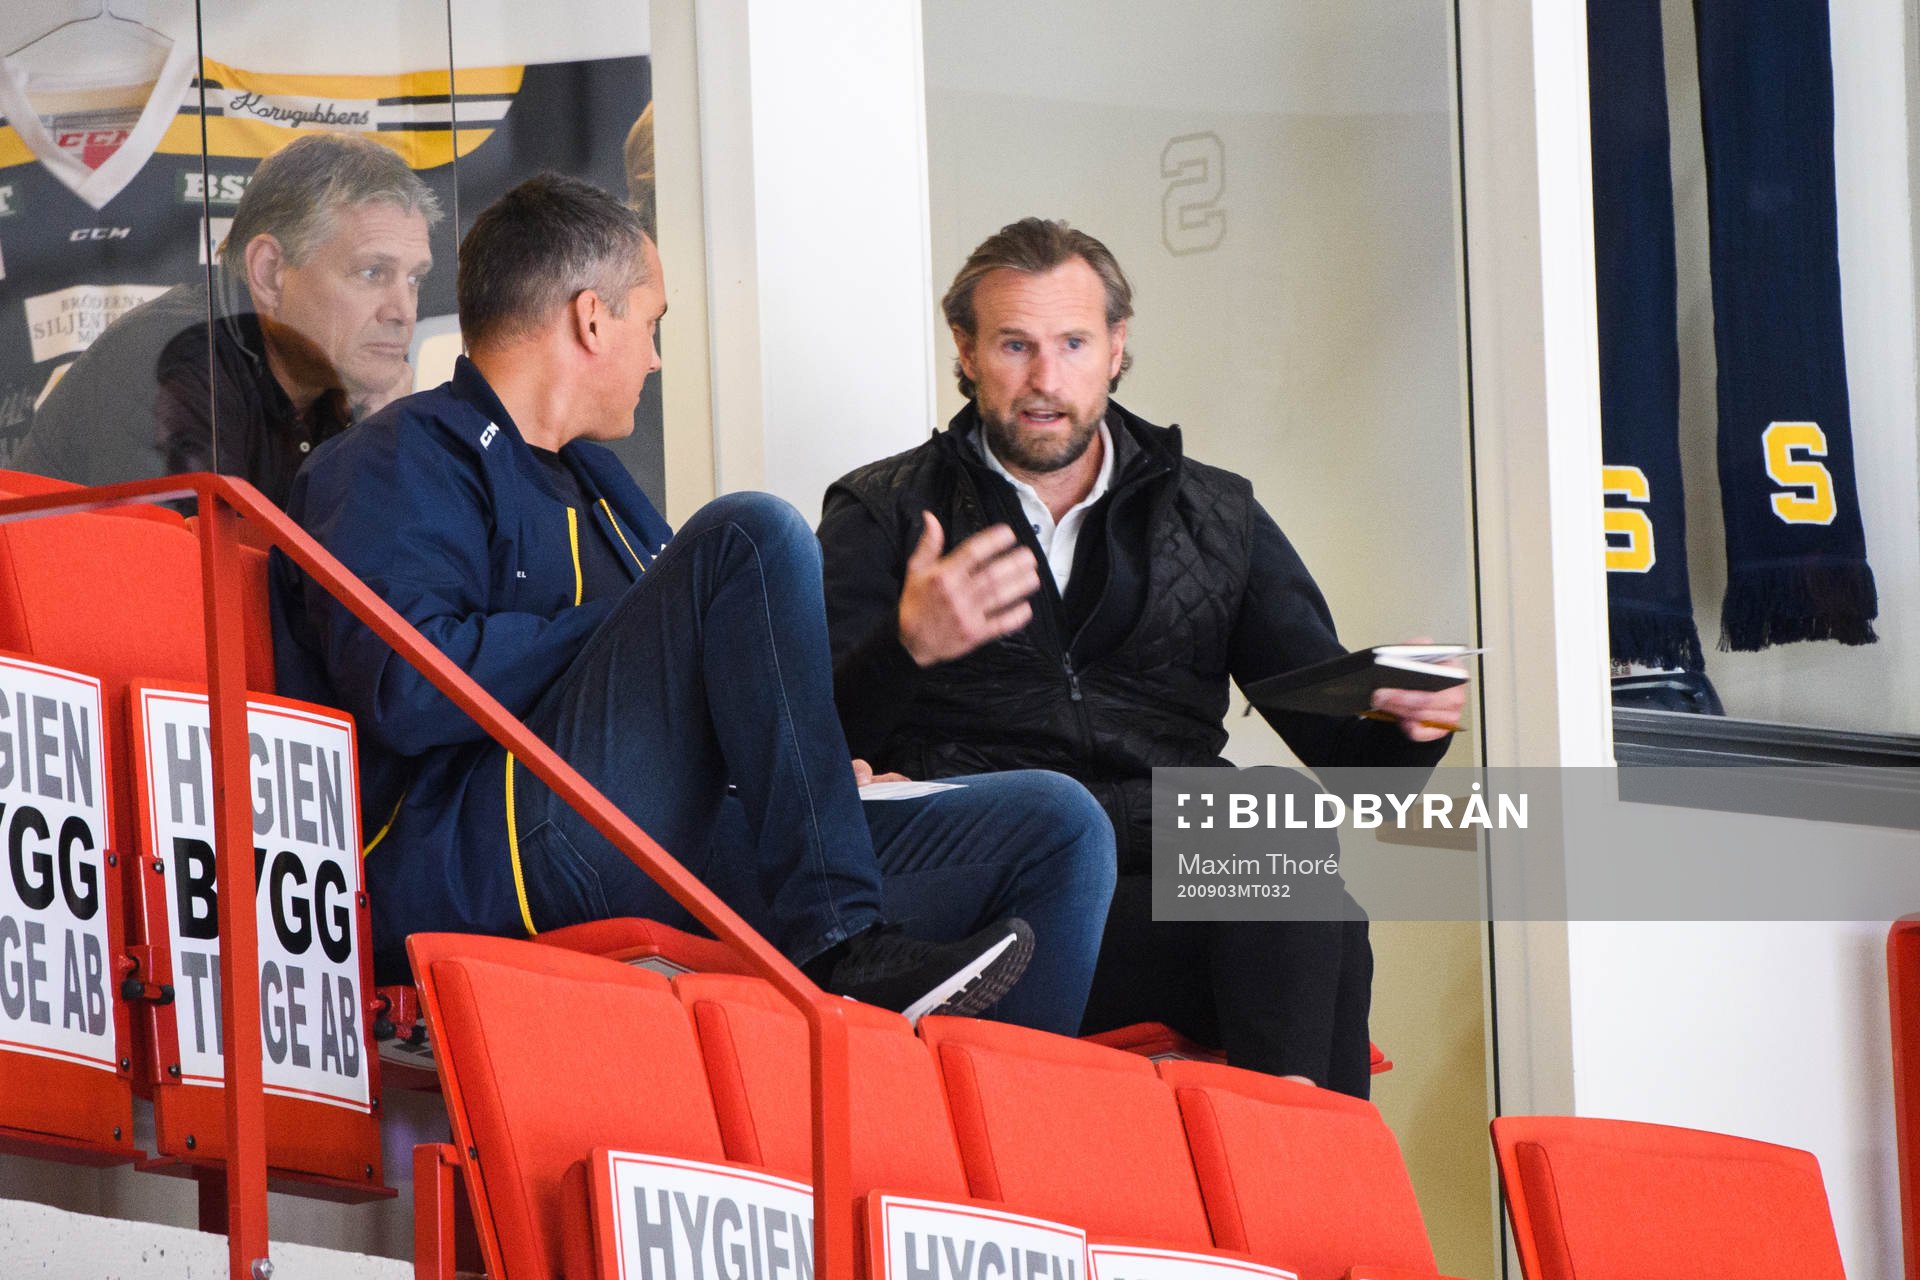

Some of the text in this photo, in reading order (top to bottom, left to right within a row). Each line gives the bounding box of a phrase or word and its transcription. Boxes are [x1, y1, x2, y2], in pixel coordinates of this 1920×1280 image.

[229, 92, 371, 128] Korvgubbens
[69, 227, 132, 242] CCM
[184, 172, 253, 200] BS
[1762, 421, 1837, 526] S
[0, 803, 99, 921] GG
[172, 836, 352, 964] BGG
[63, 928, 106, 1037] AB
[321, 972, 360, 1078] AB
